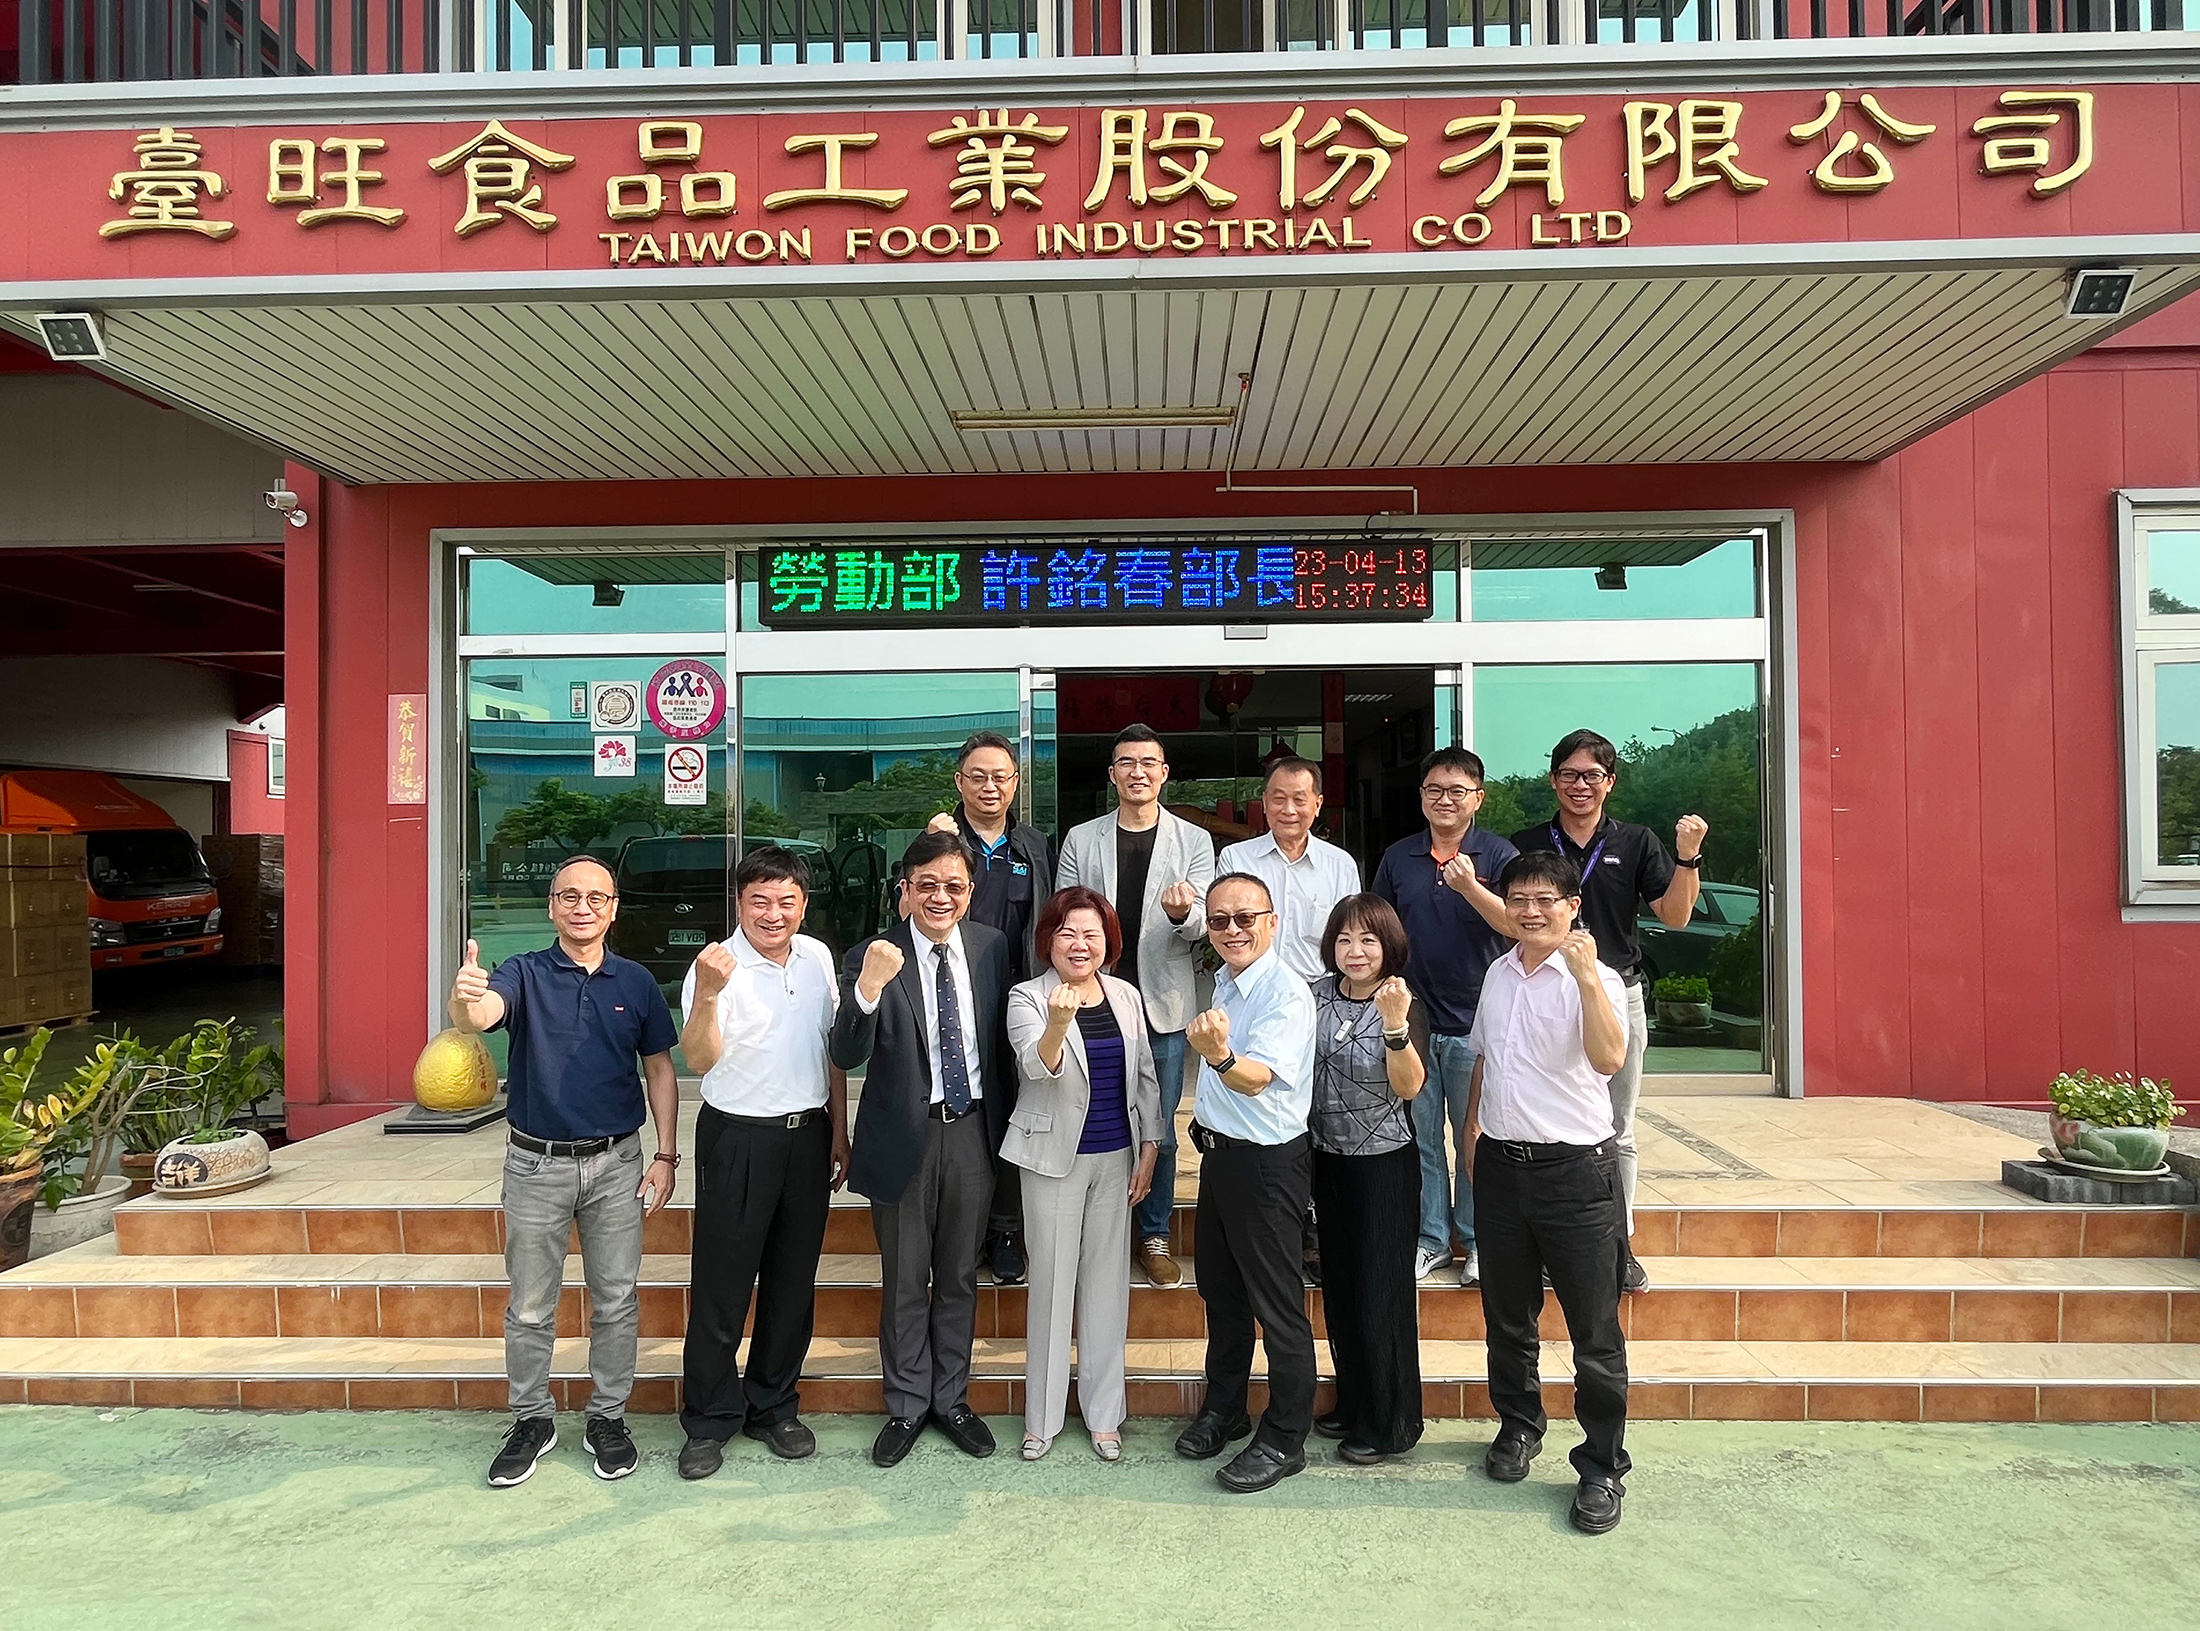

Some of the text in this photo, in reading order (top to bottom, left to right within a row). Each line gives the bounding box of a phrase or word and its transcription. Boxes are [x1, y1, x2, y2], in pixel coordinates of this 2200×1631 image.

[99, 90, 2095, 241] 臺旺食品工業股份有限公司
[599, 210, 1632, 265] TAIWON FOOD INDUSTRIAL CO LTD
[769, 546, 1295, 613] 勞動部 許銘春部長
[1294, 550, 1428, 575] 23-04-13
[1295, 583, 1428, 609] 15:37:34
